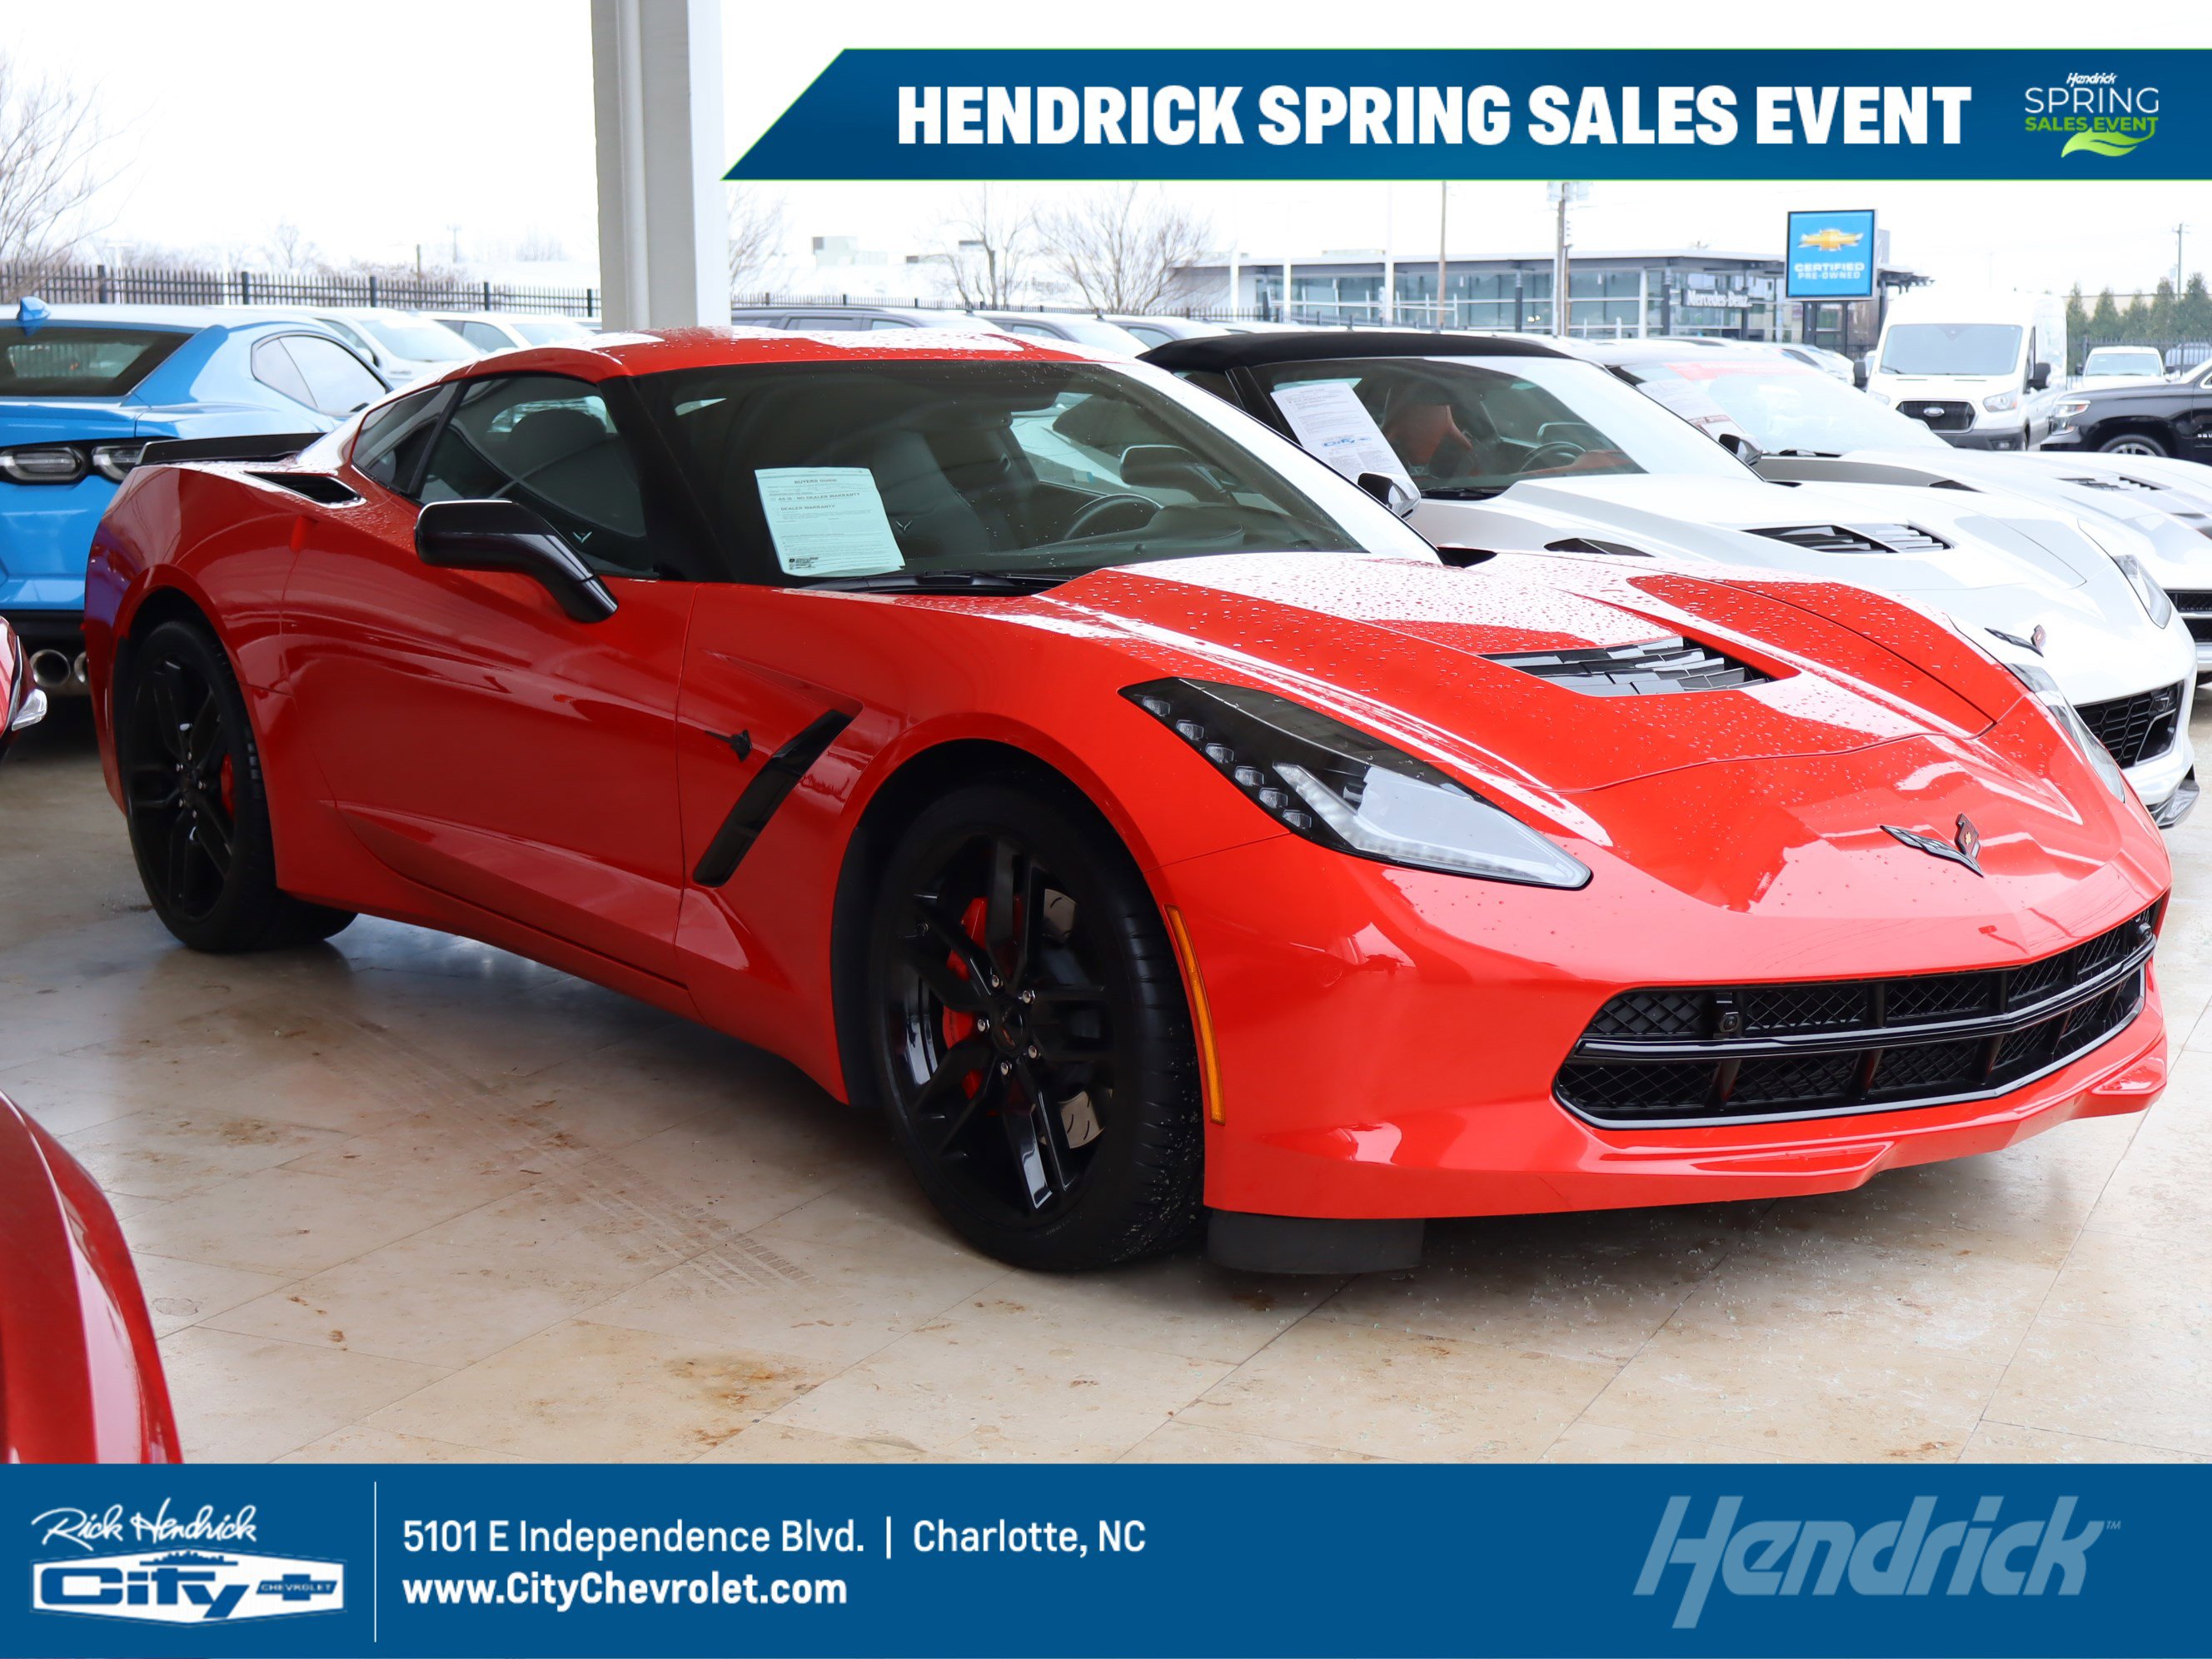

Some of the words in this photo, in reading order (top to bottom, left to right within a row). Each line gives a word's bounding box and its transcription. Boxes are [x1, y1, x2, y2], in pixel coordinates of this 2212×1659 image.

[1794, 262, 1866, 272] CERTIFIED
[1797, 271, 1861, 280] PRE-OWNED
[1688, 290, 1749, 307] Mercedes-Benz
